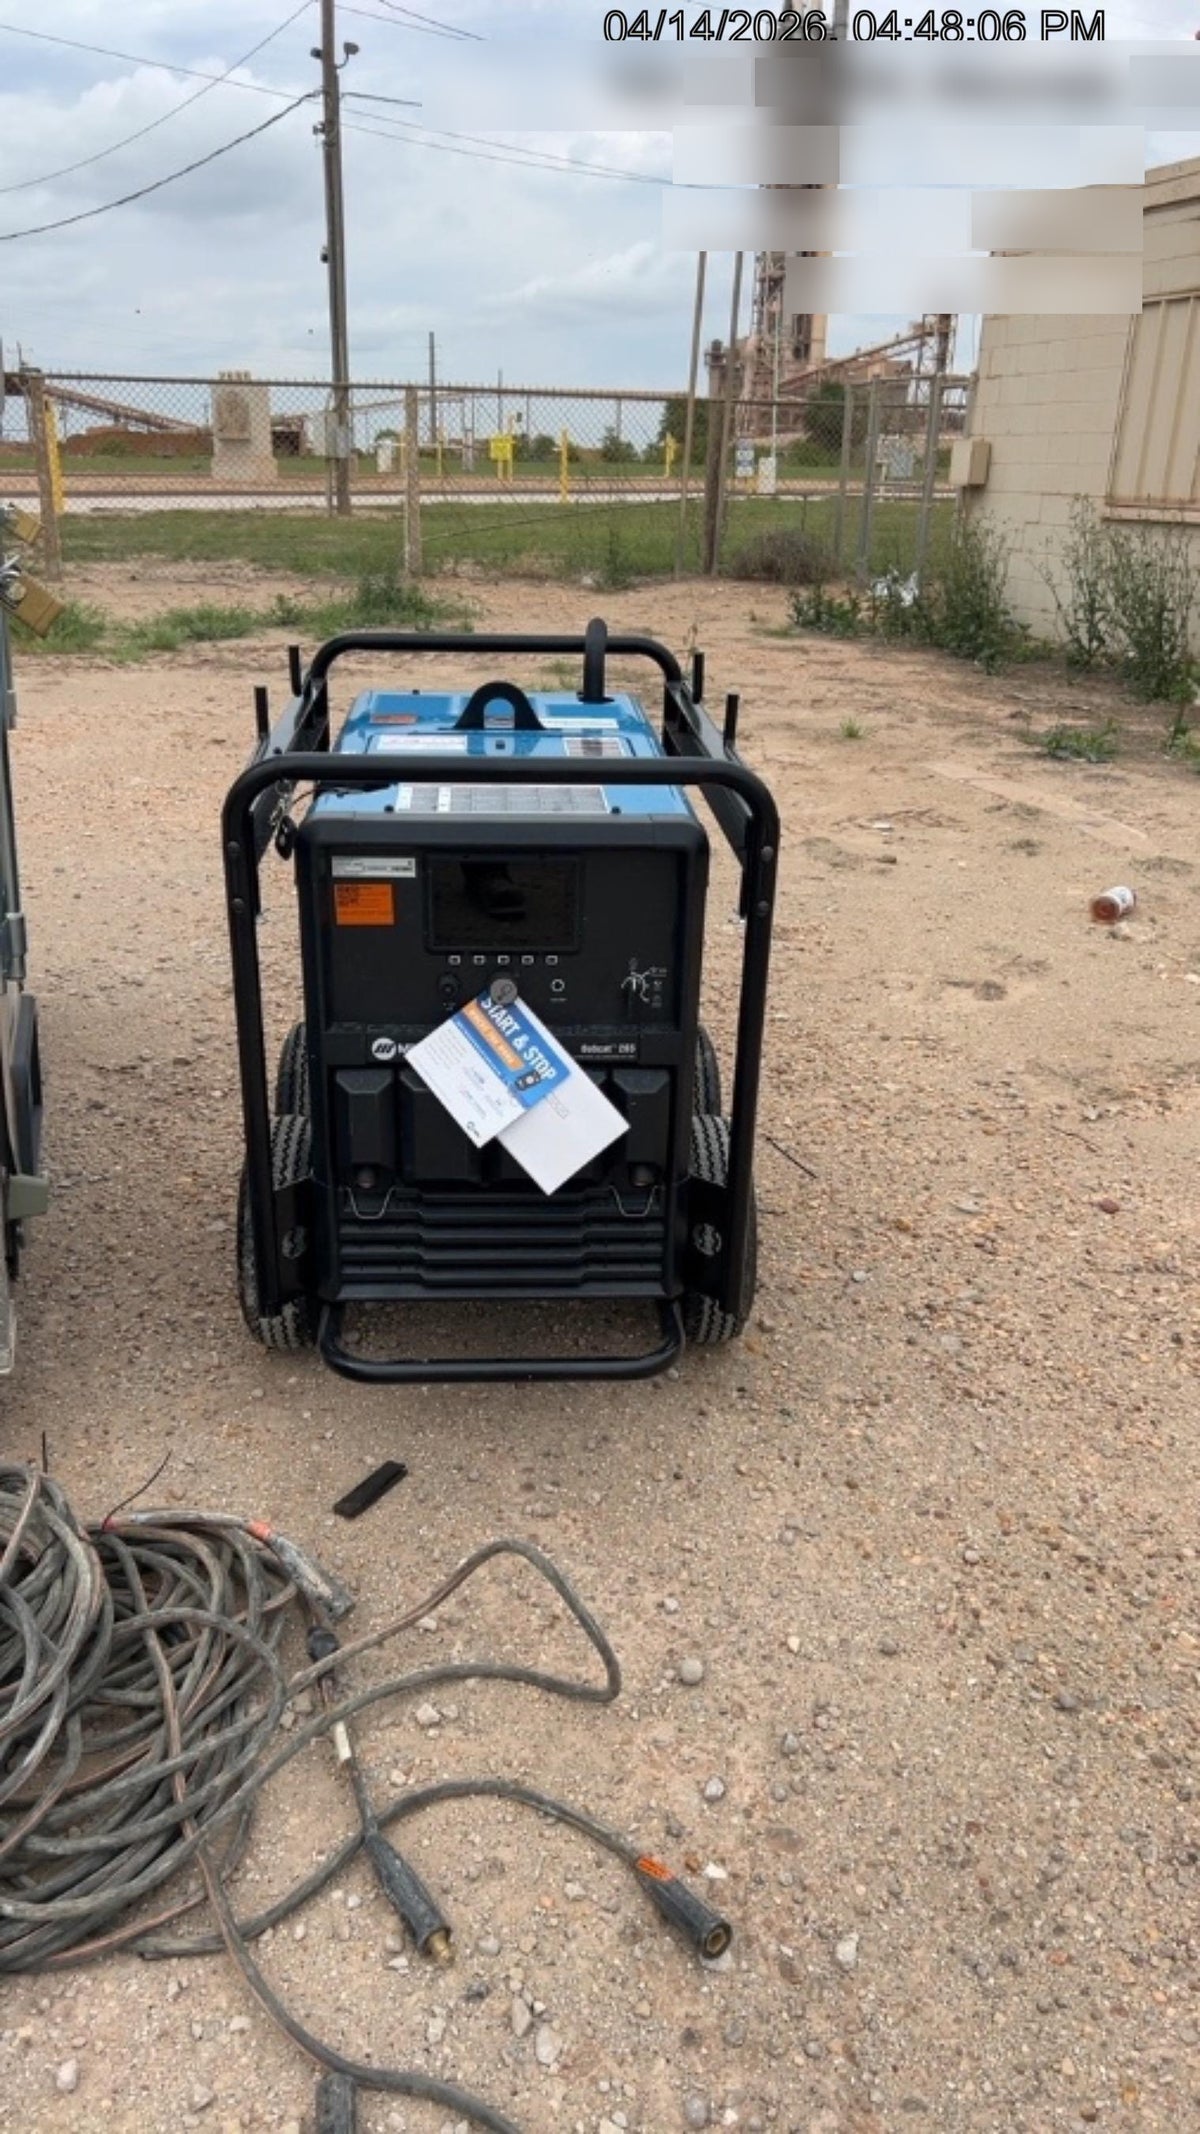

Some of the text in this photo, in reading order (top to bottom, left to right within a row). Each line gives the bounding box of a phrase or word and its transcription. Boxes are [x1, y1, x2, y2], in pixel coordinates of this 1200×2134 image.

[480, 998, 521, 1038] START
[512, 1034, 530, 1051] &
[523, 1046, 557, 1080] STOP
